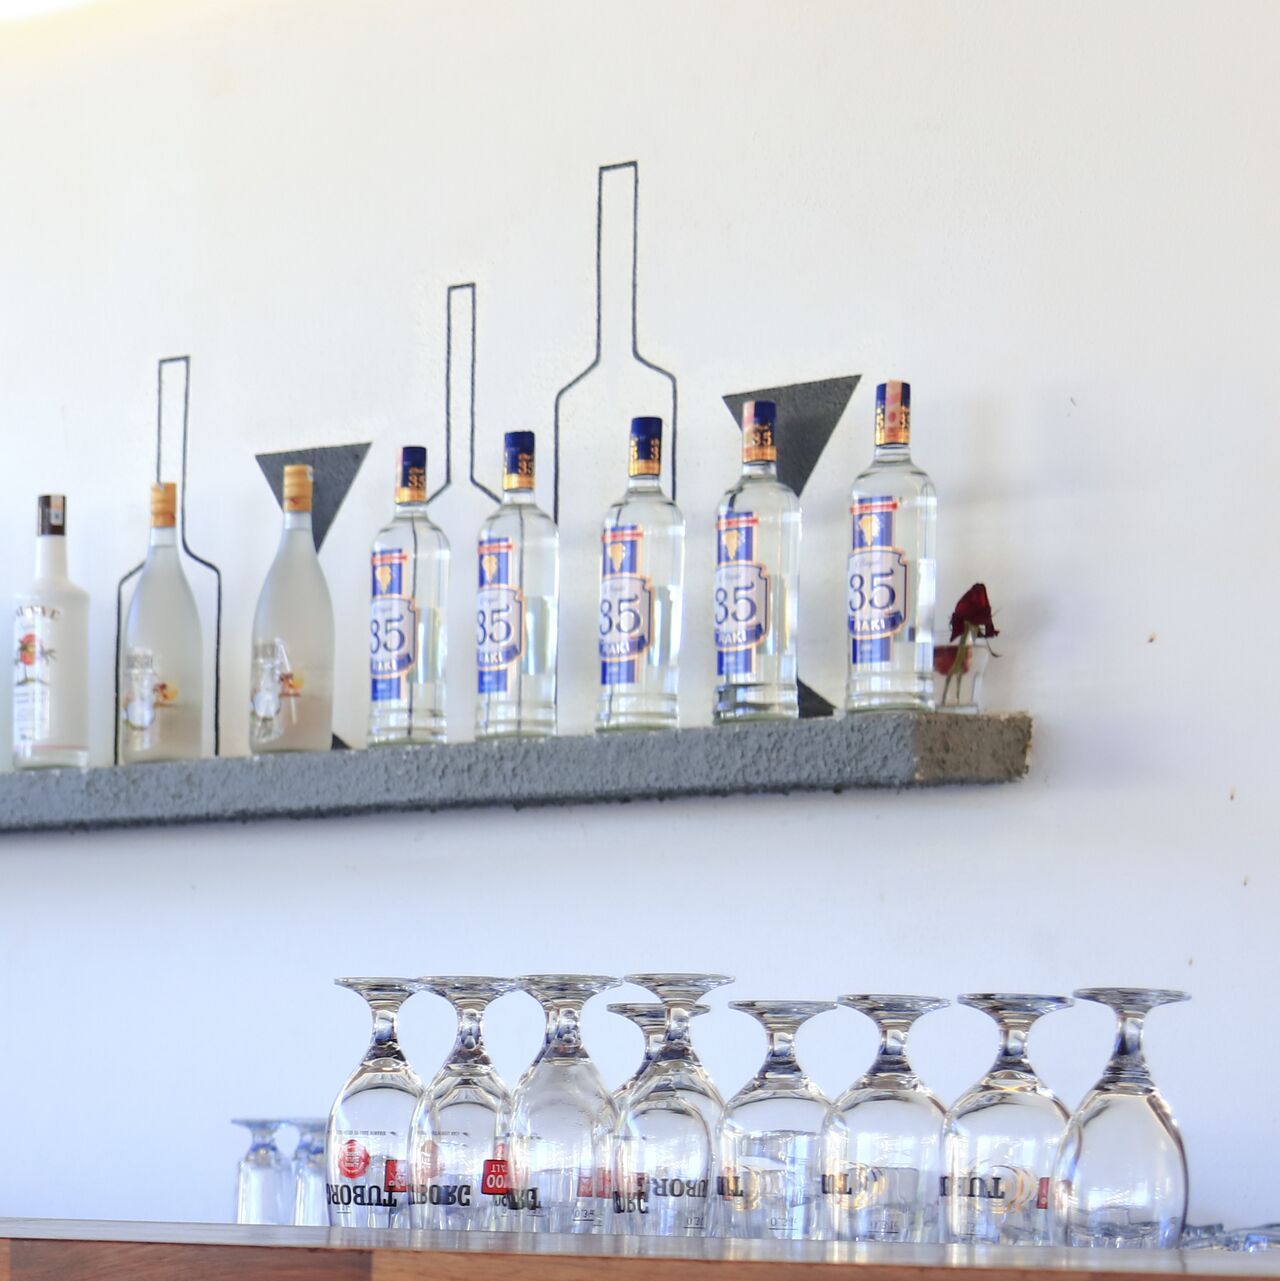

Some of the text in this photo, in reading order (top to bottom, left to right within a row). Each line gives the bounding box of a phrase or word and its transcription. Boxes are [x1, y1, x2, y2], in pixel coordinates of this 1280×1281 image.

[715, 582, 757, 625] 35
[849, 567, 896, 612] 35
[370, 614, 406, 654] 35
[477, 605, 512, 646] 35
[599, 594, 641, 636] 35
